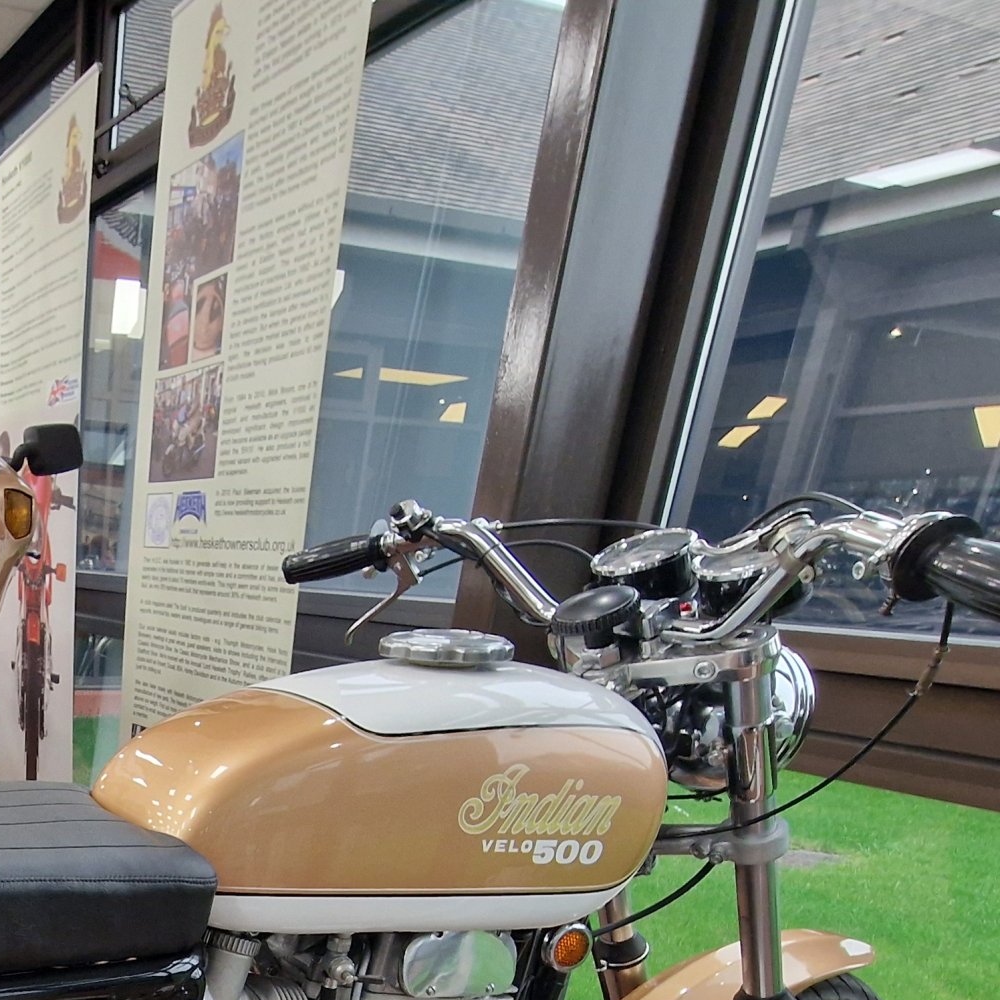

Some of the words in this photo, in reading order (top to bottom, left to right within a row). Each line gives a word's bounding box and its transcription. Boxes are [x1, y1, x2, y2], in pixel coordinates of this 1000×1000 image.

[457, 763, 622, 836] Indian
[482, 839, 533, 854] VELO
[532, 839, 604, 865] 500
